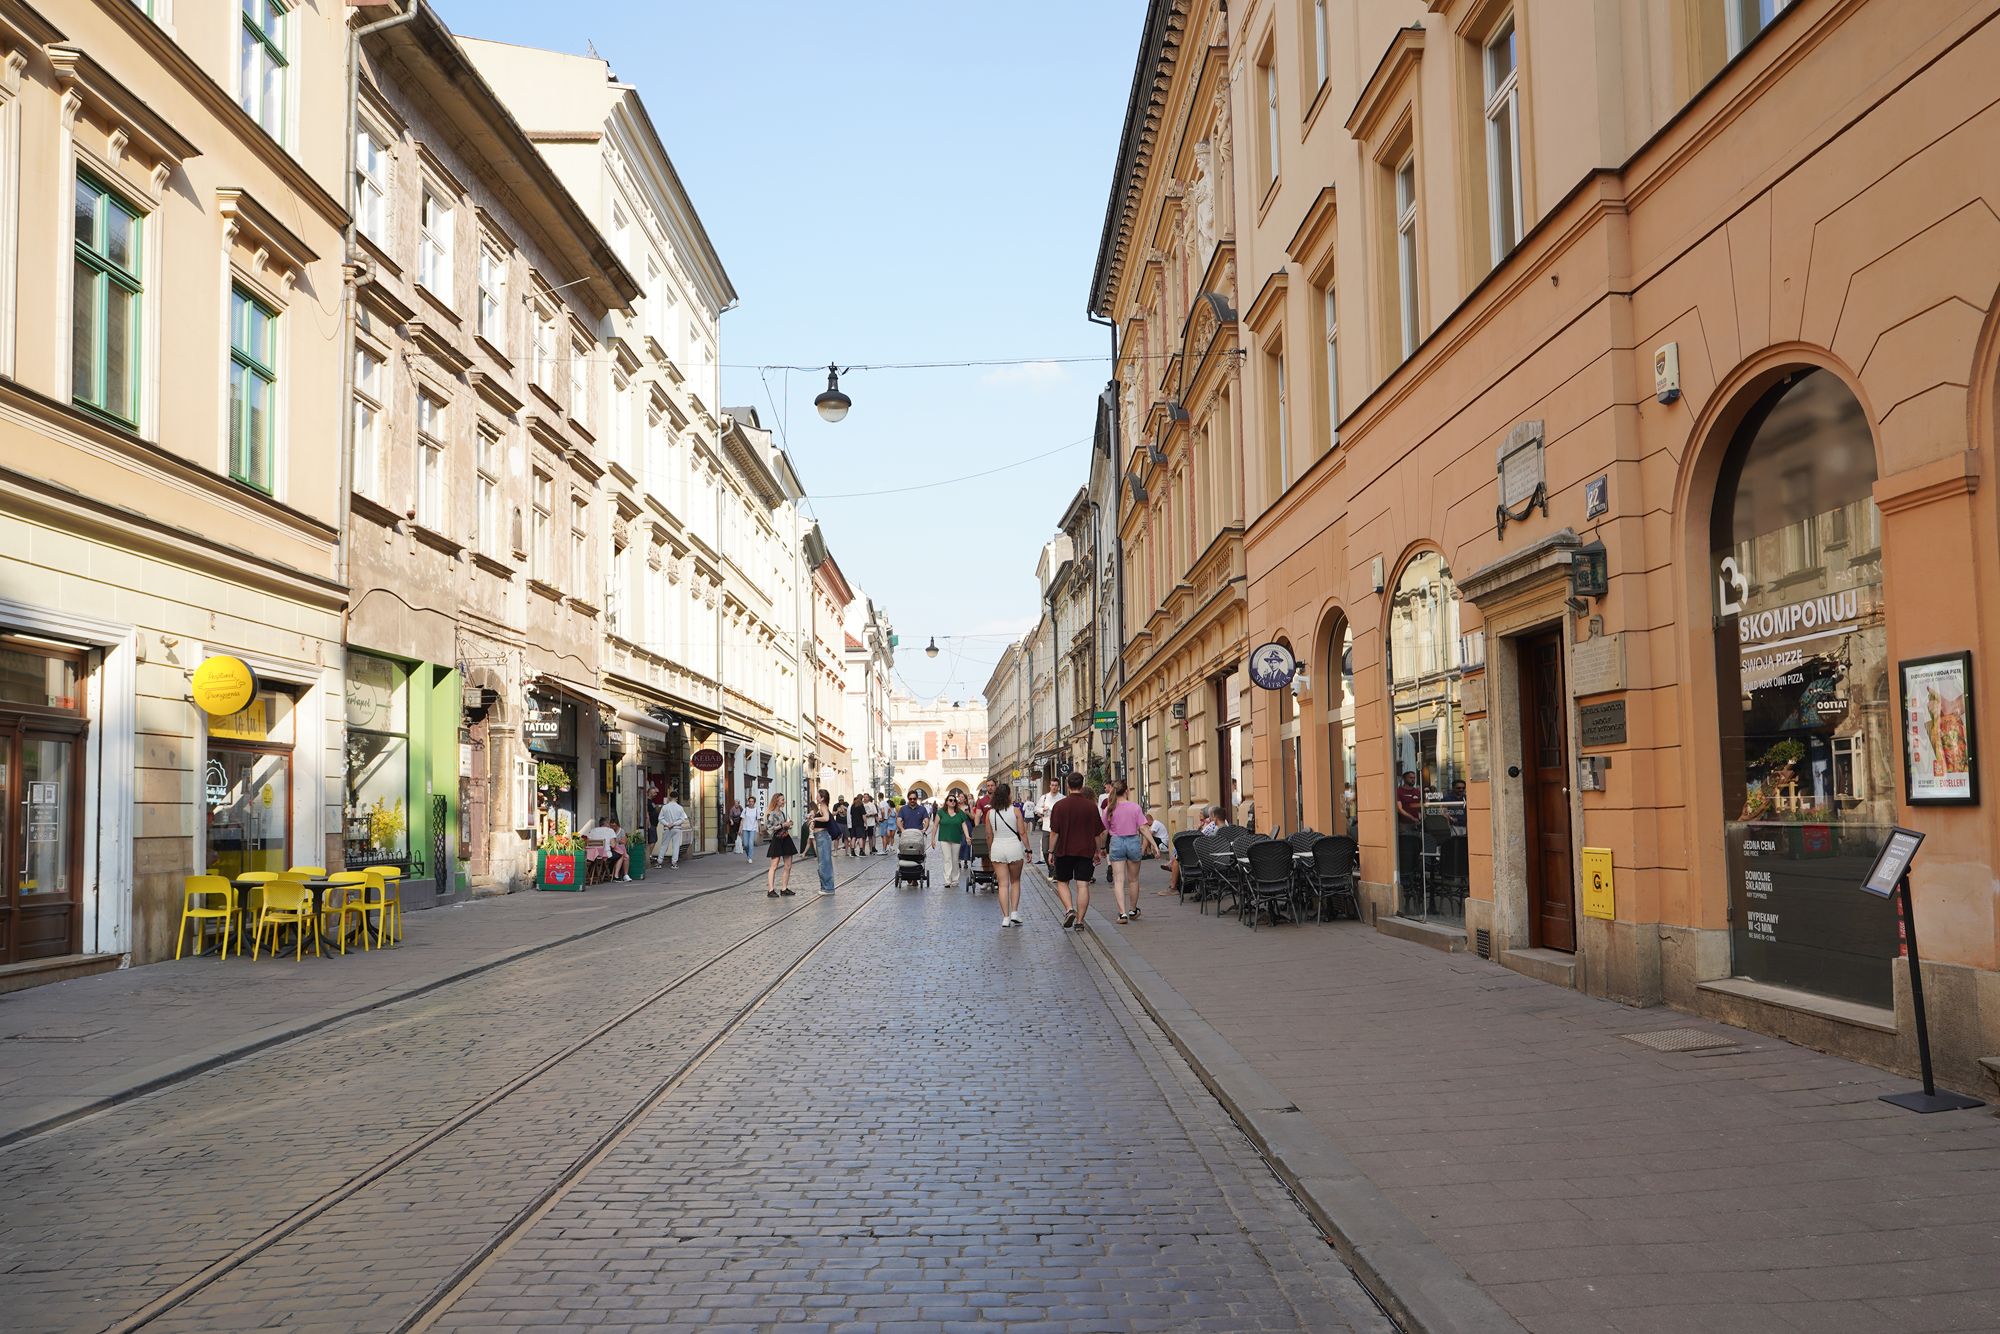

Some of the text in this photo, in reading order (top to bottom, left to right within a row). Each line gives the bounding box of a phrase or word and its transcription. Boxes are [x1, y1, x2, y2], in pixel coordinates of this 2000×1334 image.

[1588, 488, 1599, 508] 22
[1739, 590, 1857, 642] SKOMPONUJ
[1742, 649, 1803, 673] SWOJĄ PIZZĘ
[1743, 673, 1804, 692] BUILD YOUR OWN PIZZA
[524, 722, 558, 732] TATTOO
[1939, 779, 1966, 788] EXCELLENT
[1743, 840, 1776, 851] JEDNA CENA
[1593, 873, 1602, 890] G
[1745, 871, 1771, 882] DOWOLNE
[1746, 881, 1773, 892] SKŁADNIKI
[1747, 911, 1779, 925] WYPIEKAMY
[1748, 921, 1754, 931] W
[1761, 923, 1774, 934] MIN.
